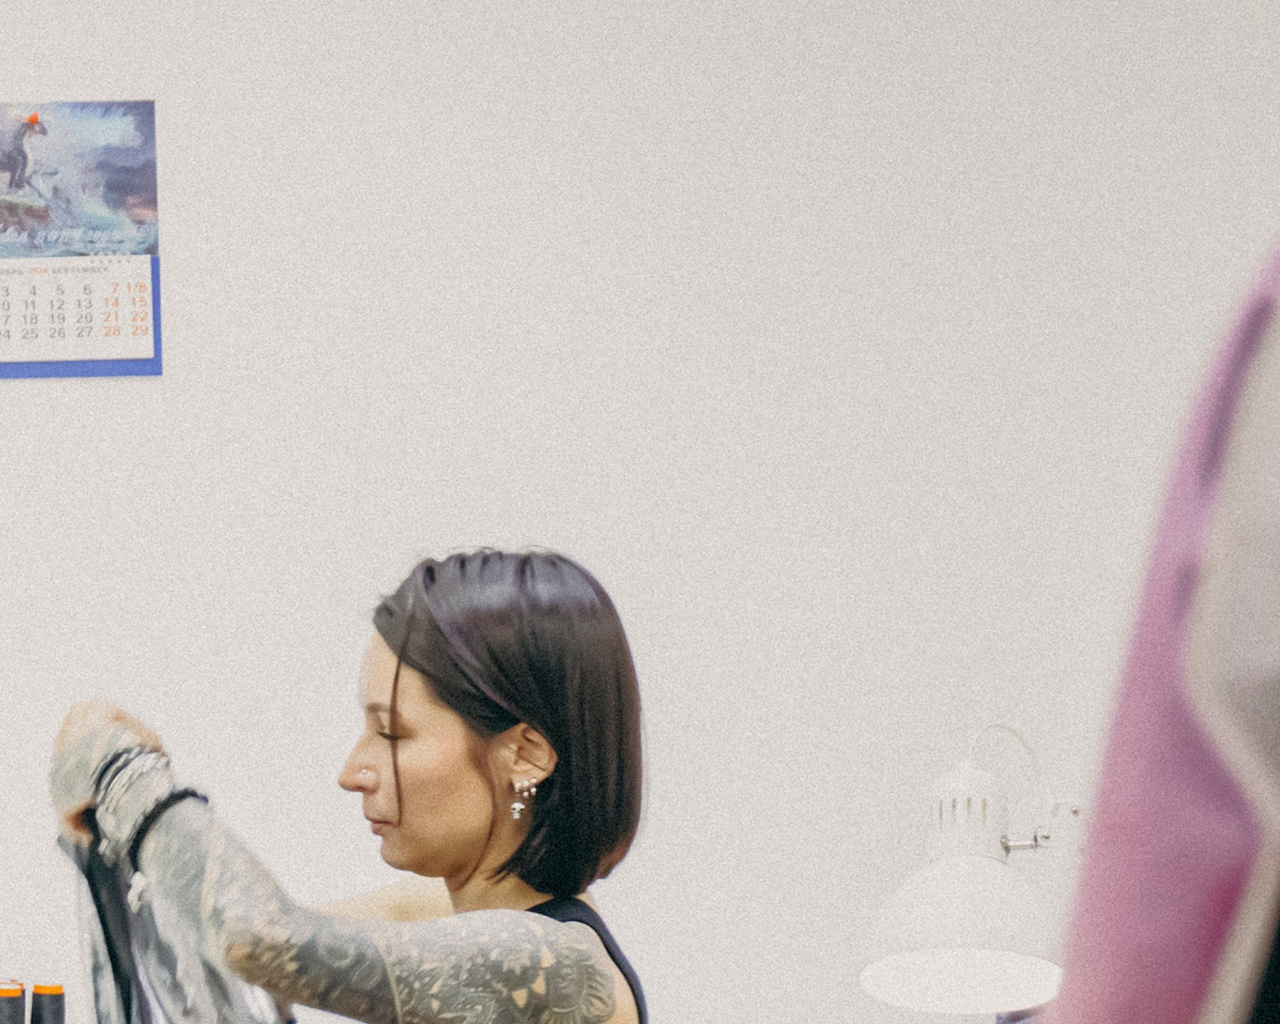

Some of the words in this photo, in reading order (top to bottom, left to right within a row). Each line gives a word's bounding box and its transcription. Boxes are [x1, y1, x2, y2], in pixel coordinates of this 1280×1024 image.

[1, 285, 10, 298] 3
[29, 285, 37, 296] 4
[56, 285, 64, 296] 5
[83, 283, 92, 295] 6
[111, 282, 119, 294] 7
[23, 300, 36, 311] 11
[50, 299, 65, 310] 12
[77, 298, 93, 310] 13
[104, 296, 119, 308] 14
[132, 296, 148, 308] 15
[22, 313, 38, 325] 18
[51, 313, 66, 324] 19
[76, 312, 93, 323] 20
[102, 311, 119, 323] 21
[130, 310, 148, 322] 22
[21, 328, 38, 340] 25
[48, 327, 66, 339] 26
[76, 326, 93, 338] 27
[103, 325, 121, 337] 28
[131, 324, 149, 336] 29
